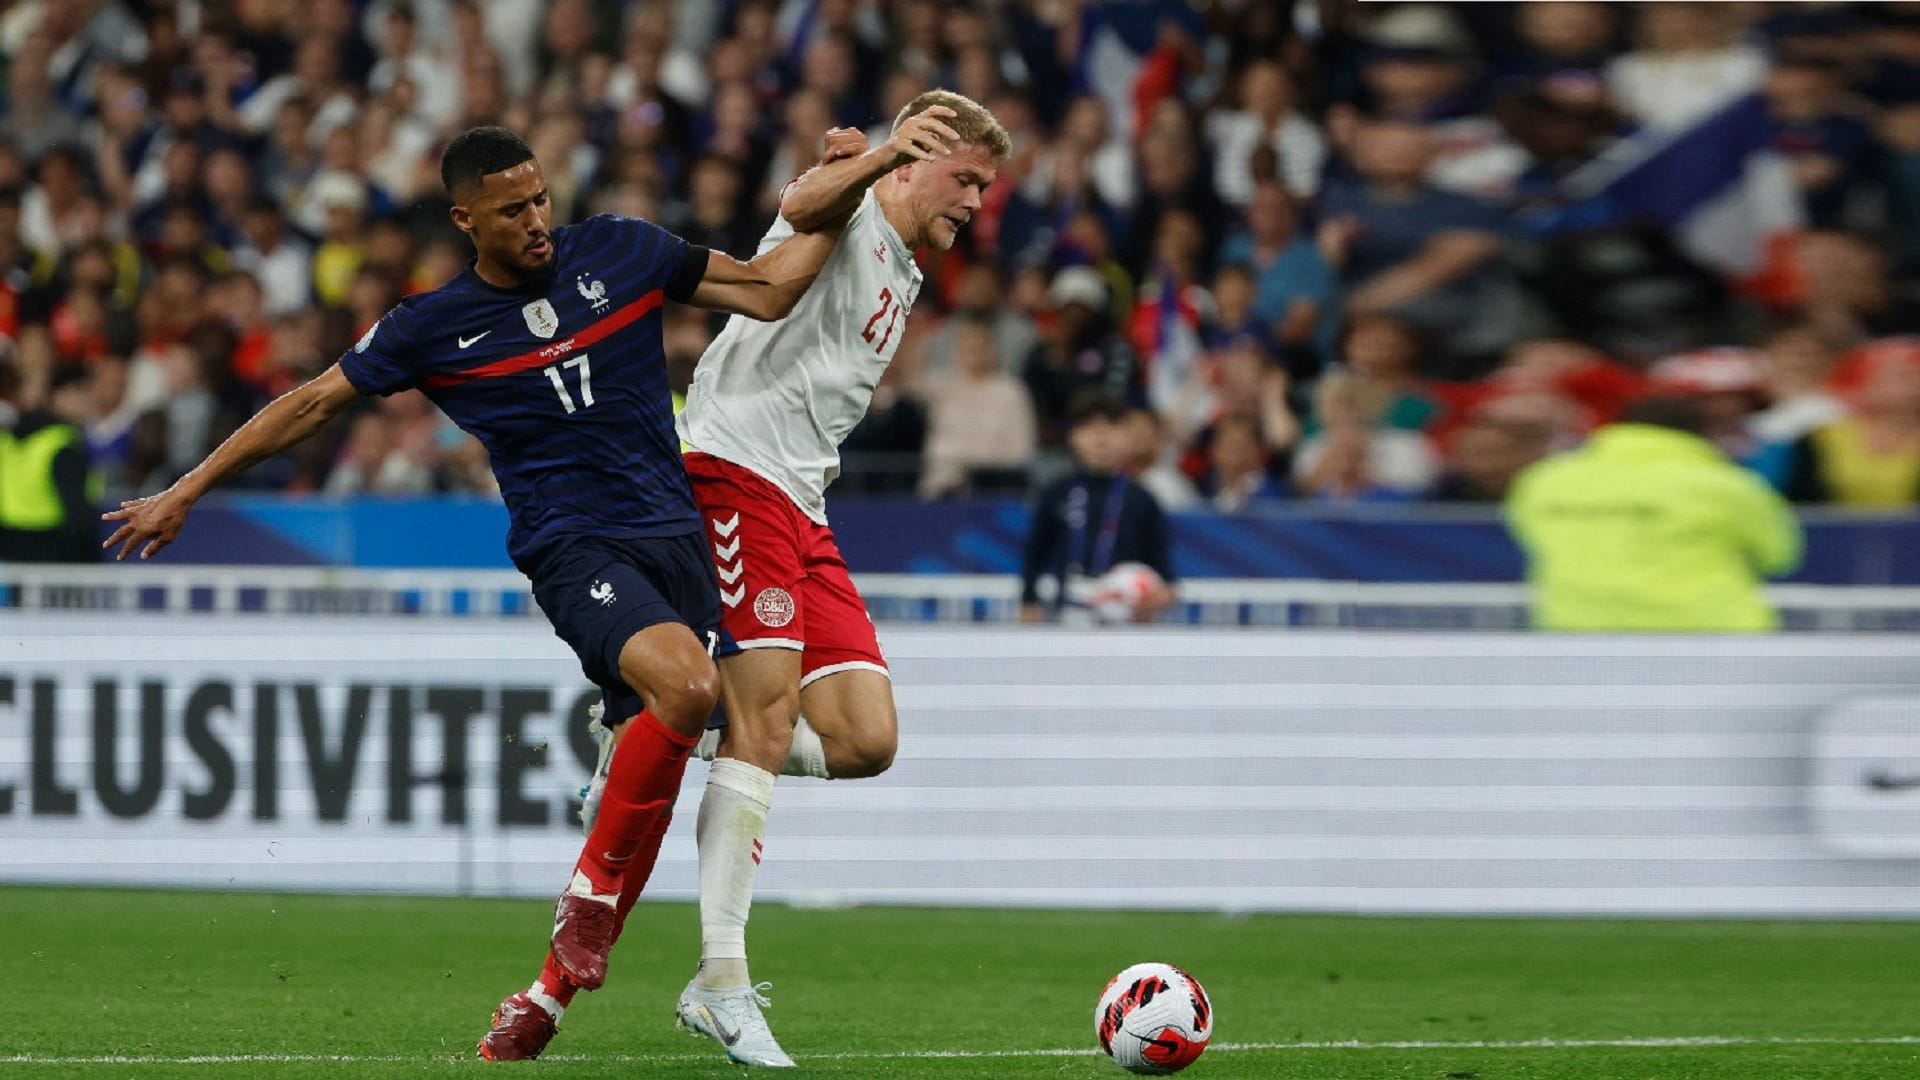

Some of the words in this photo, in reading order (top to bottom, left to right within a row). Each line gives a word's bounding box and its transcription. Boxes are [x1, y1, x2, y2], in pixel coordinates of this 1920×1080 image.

[861, 287, 900, 355] 21
[544, 353, 595, 415] 17
[706, 630, 720, 660] 1
[0, 675, 602, 829] LUSIVITES
